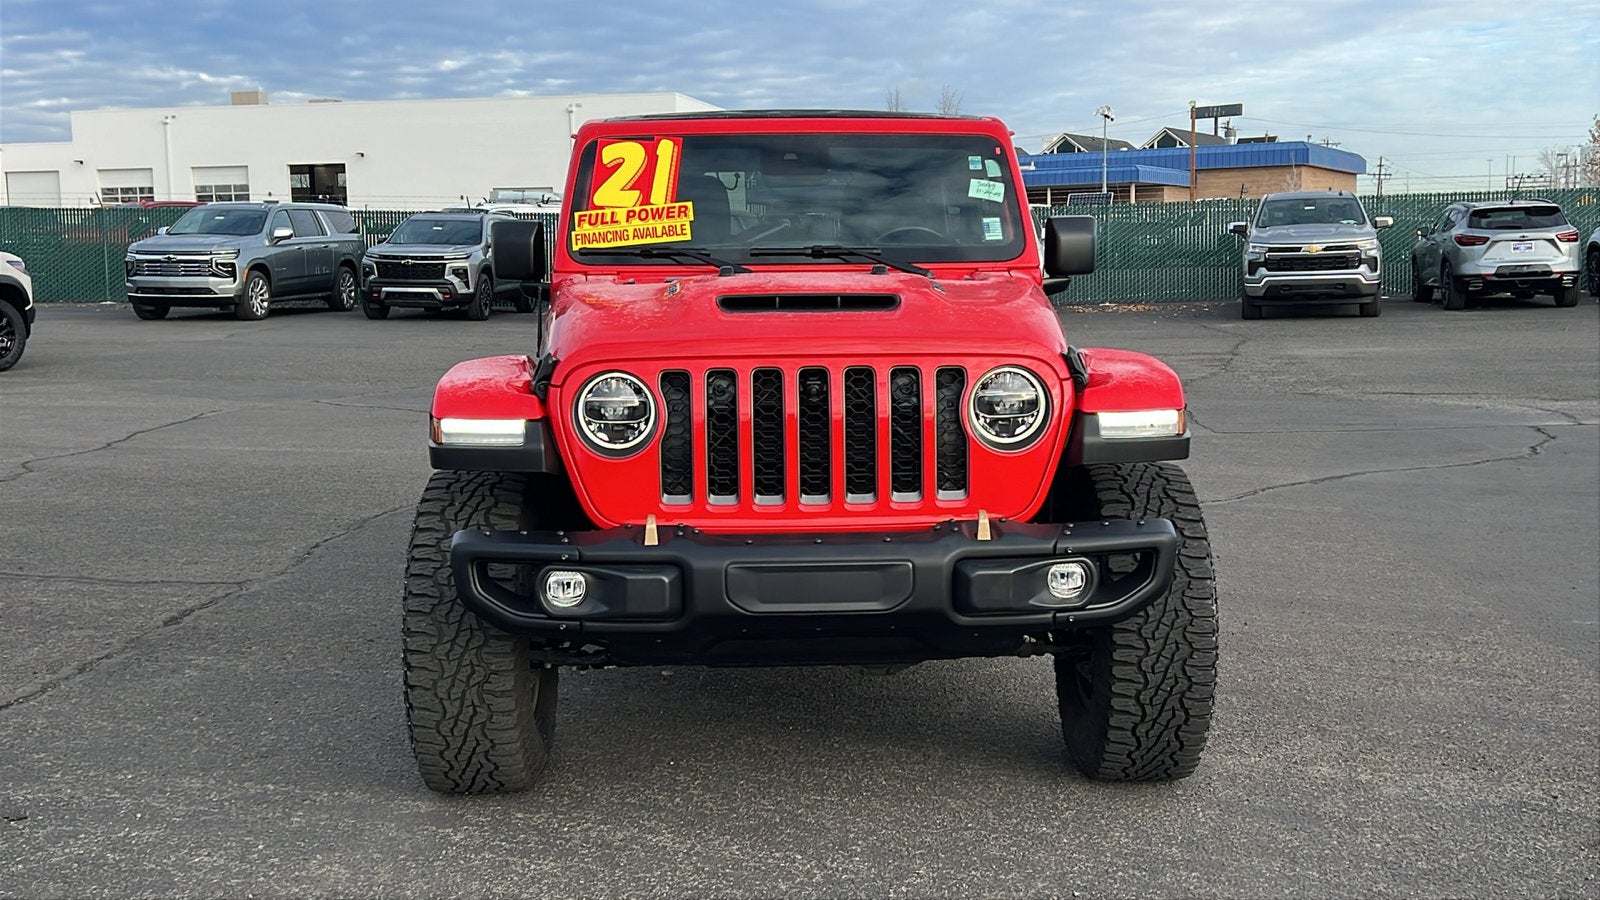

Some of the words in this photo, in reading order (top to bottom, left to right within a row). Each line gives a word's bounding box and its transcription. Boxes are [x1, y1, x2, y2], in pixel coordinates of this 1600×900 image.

[593, 139, 675, 208] 21
[577, 211, 619, 228] FULL
[626, 205, 689, 223] POWER
[574, 229, 629, 246] FINANCING
[632, 223, 687, 240] AVAILABLE
